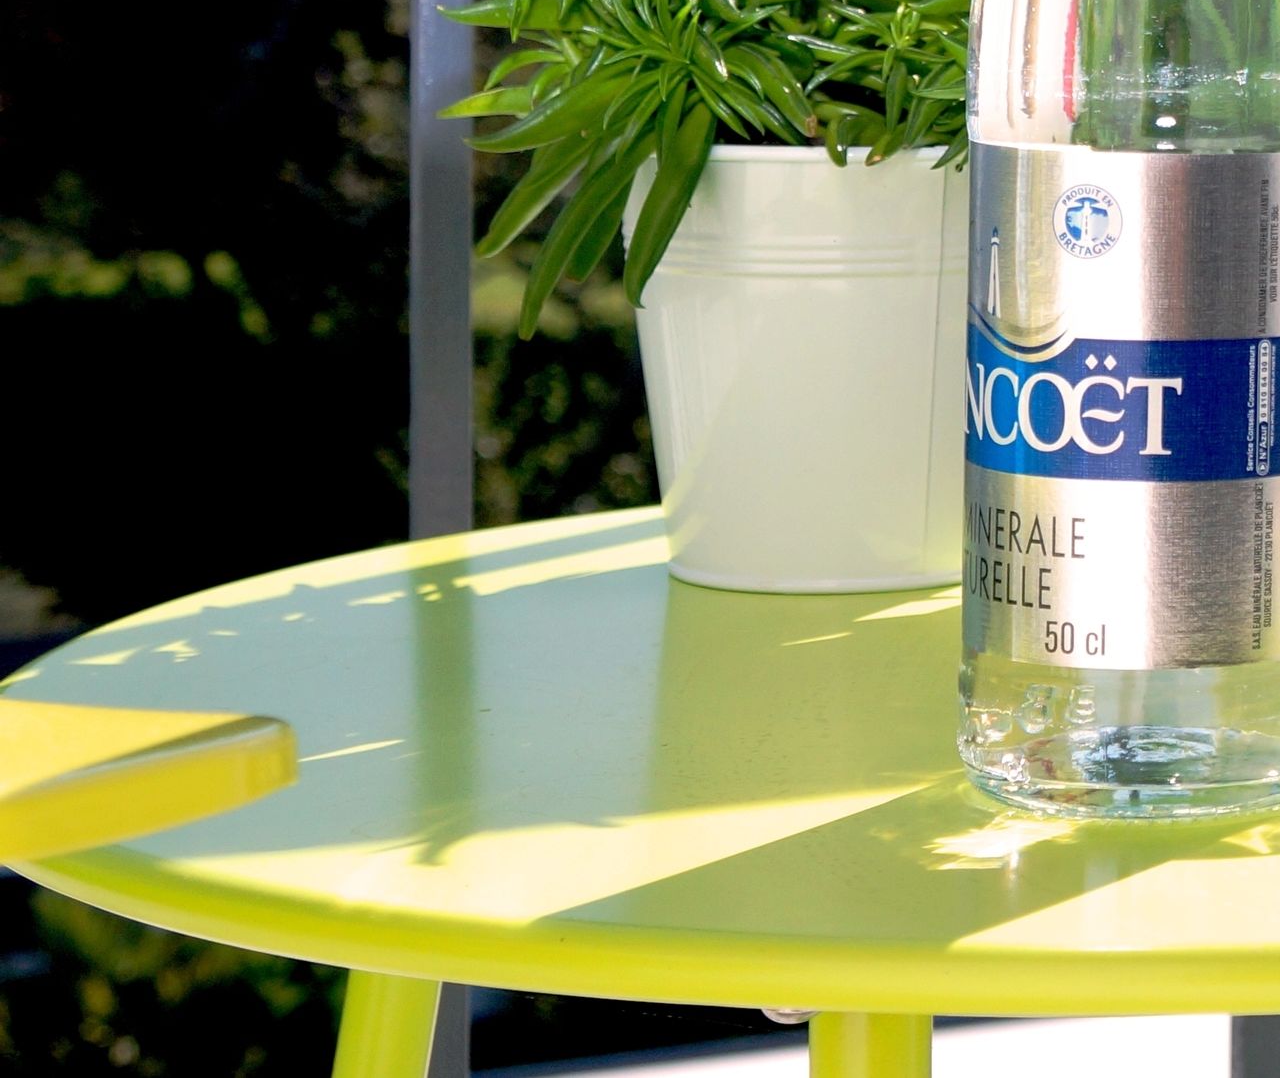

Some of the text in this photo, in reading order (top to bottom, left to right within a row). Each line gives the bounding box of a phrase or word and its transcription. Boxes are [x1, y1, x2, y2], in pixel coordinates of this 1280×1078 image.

[1062, 187, 1114, 207] PRODUIT EN
[1059, 232, 1116, 256] BRETAGNE
[1246, 345, 1256, 472] Service Conseils Consommateurs
[1253, 614, 1261, 629] EAU
[1263, 598, 1272, 628] SOURCE
[1044, 620, 1106, 656] 50 cl
